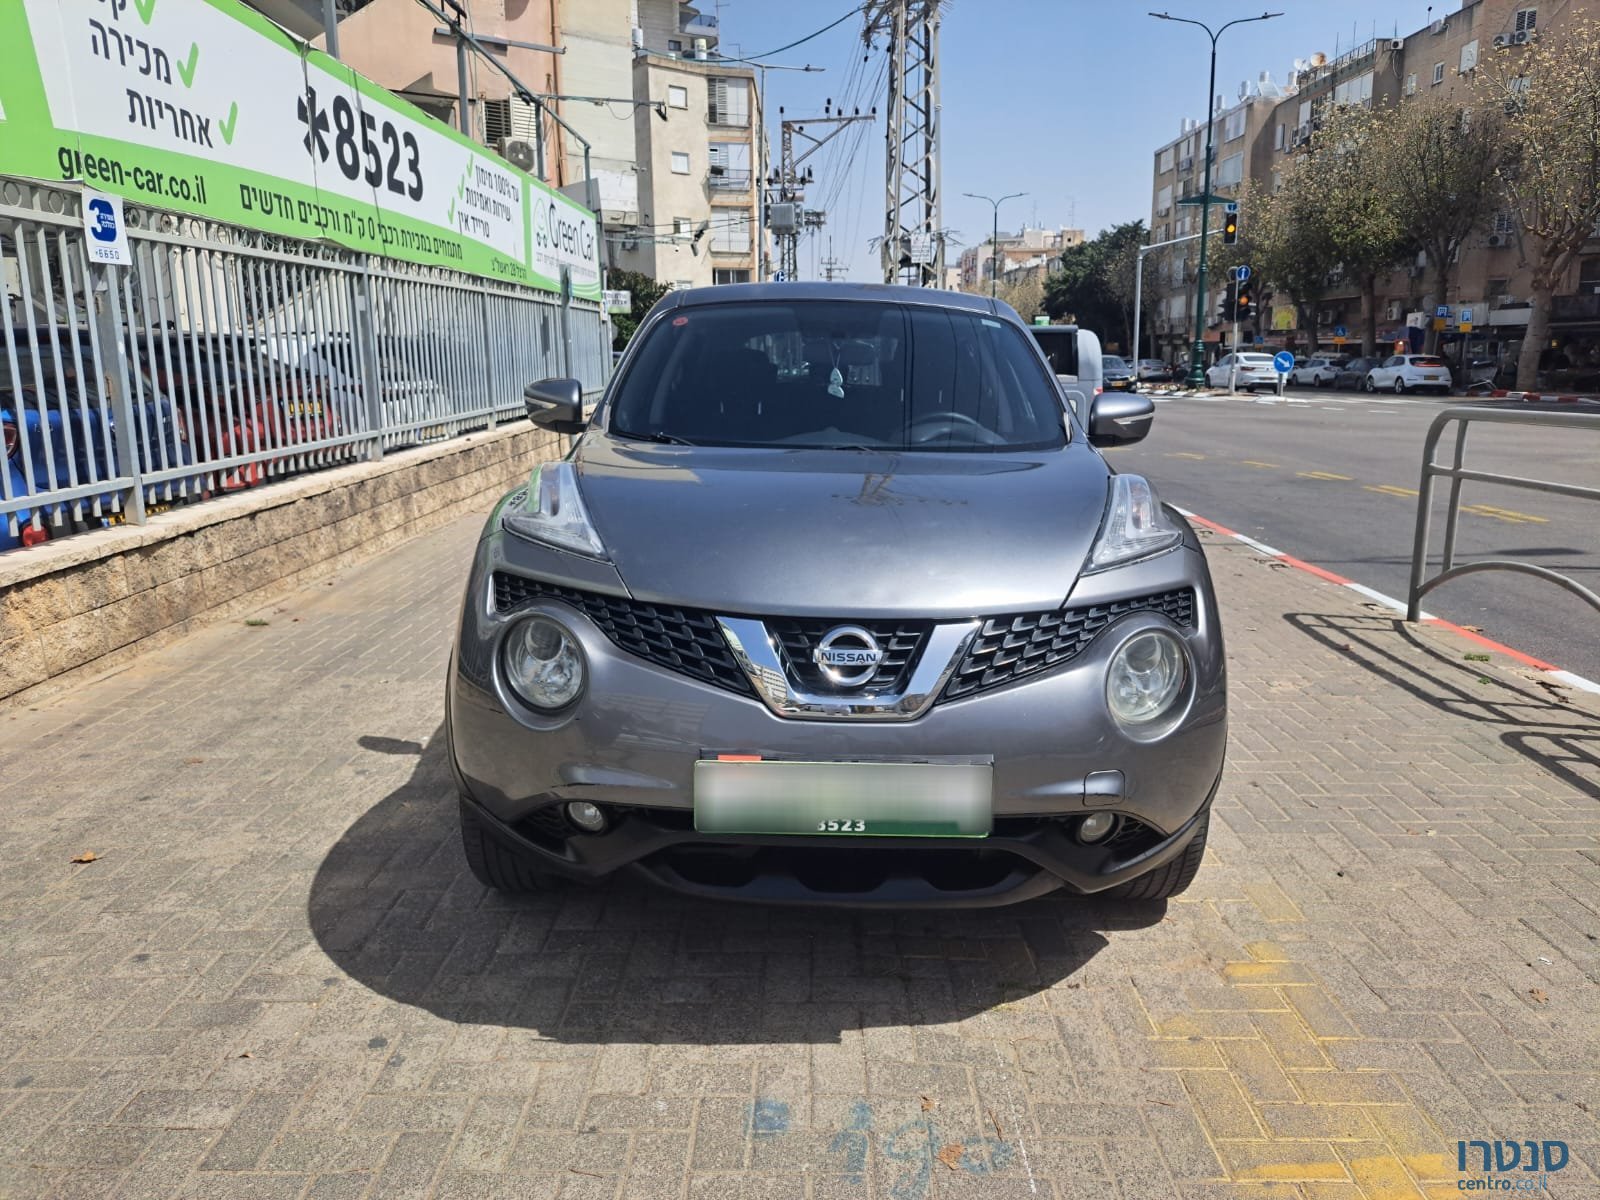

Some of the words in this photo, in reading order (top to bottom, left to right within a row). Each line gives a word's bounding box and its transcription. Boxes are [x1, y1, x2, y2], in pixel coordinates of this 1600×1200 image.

[88, 18, 172, 85] מכירה
[126, 88, 213, 148] אחריות
[58, 146, 207, 204] green-car.co.il
[475, 164, 493, 189] מימון
[240, 184, 294, 220] חדשים
[298, 200, 340, 231] ורכבים
[378, 223, 399, 246] רכבי
[458, 211, 471, 235] אין
[549, 202, 579, 257] Green
[580, 220, 594, 261] Car
[401, 229, 432, 253] במכירת
[433, 236, 463, 260] מתמחים
[820, 652, 877, 663] NISSAN
